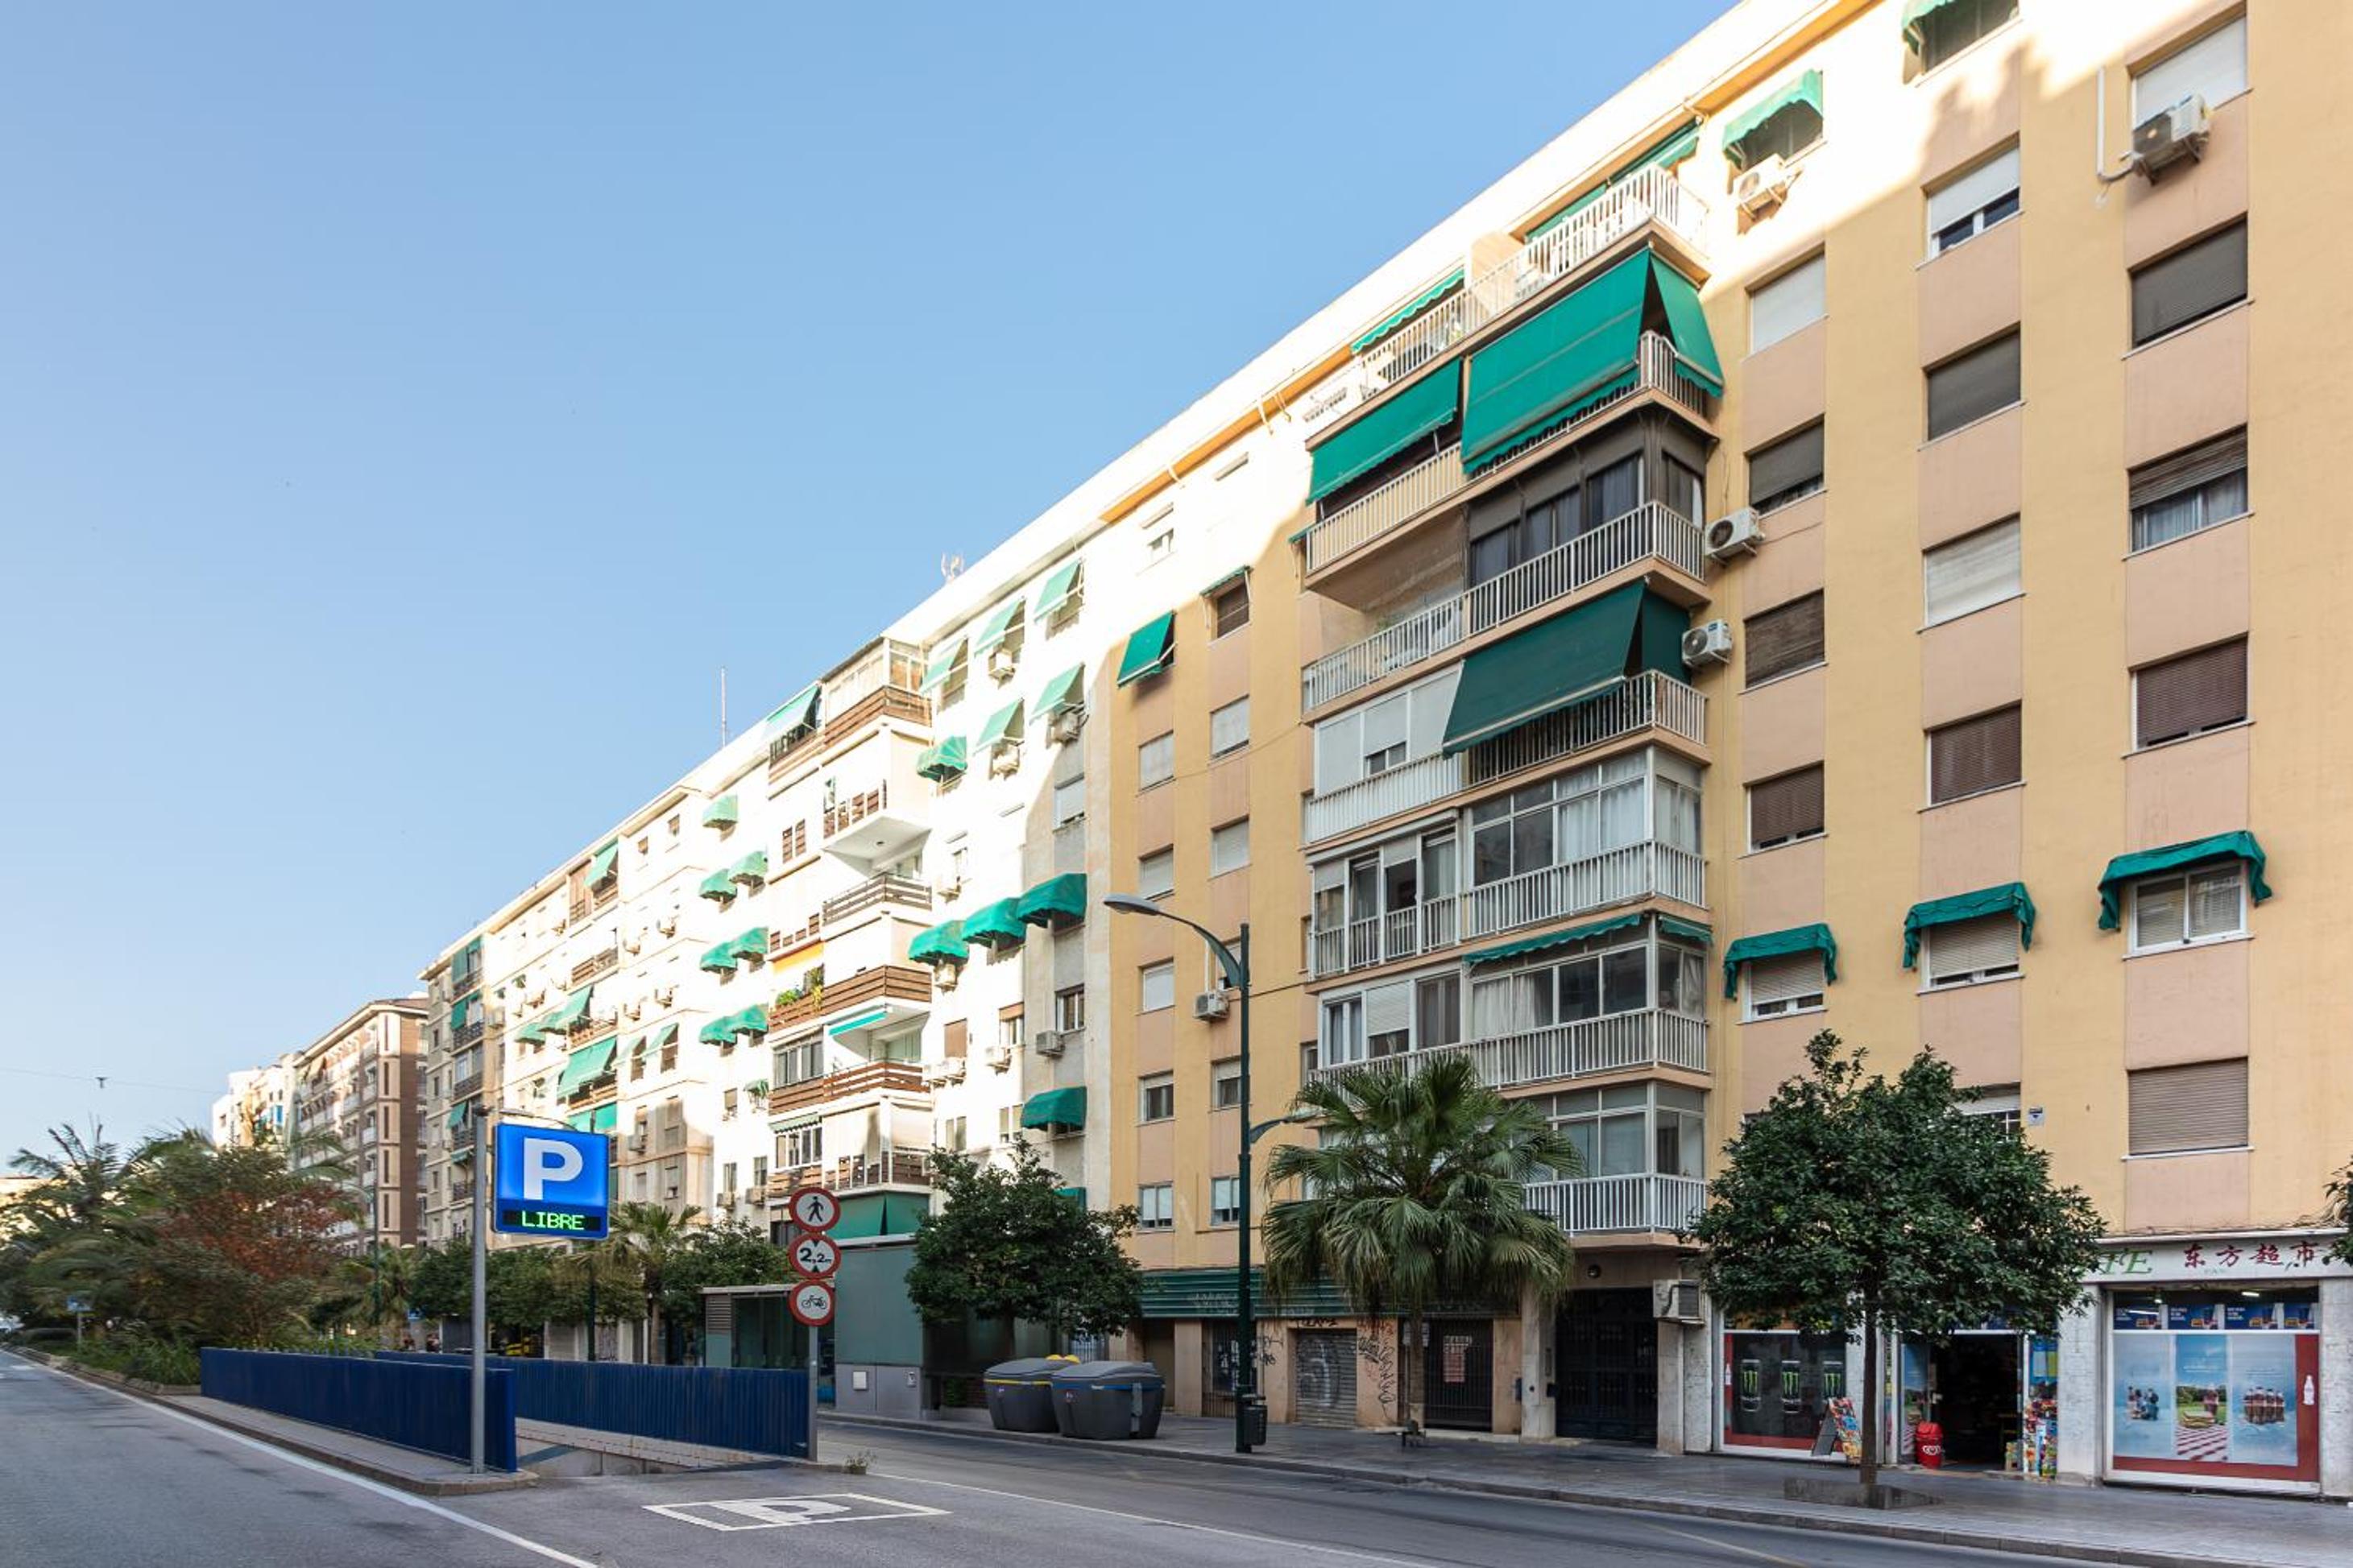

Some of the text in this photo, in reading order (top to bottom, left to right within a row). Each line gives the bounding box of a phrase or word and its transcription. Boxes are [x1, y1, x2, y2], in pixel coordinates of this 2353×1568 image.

[524, 1137, 582, 1200] P
[521, 1210, 585, 1231] LIBRE
[2183, 1240, 2318, 1268] 东方超市
